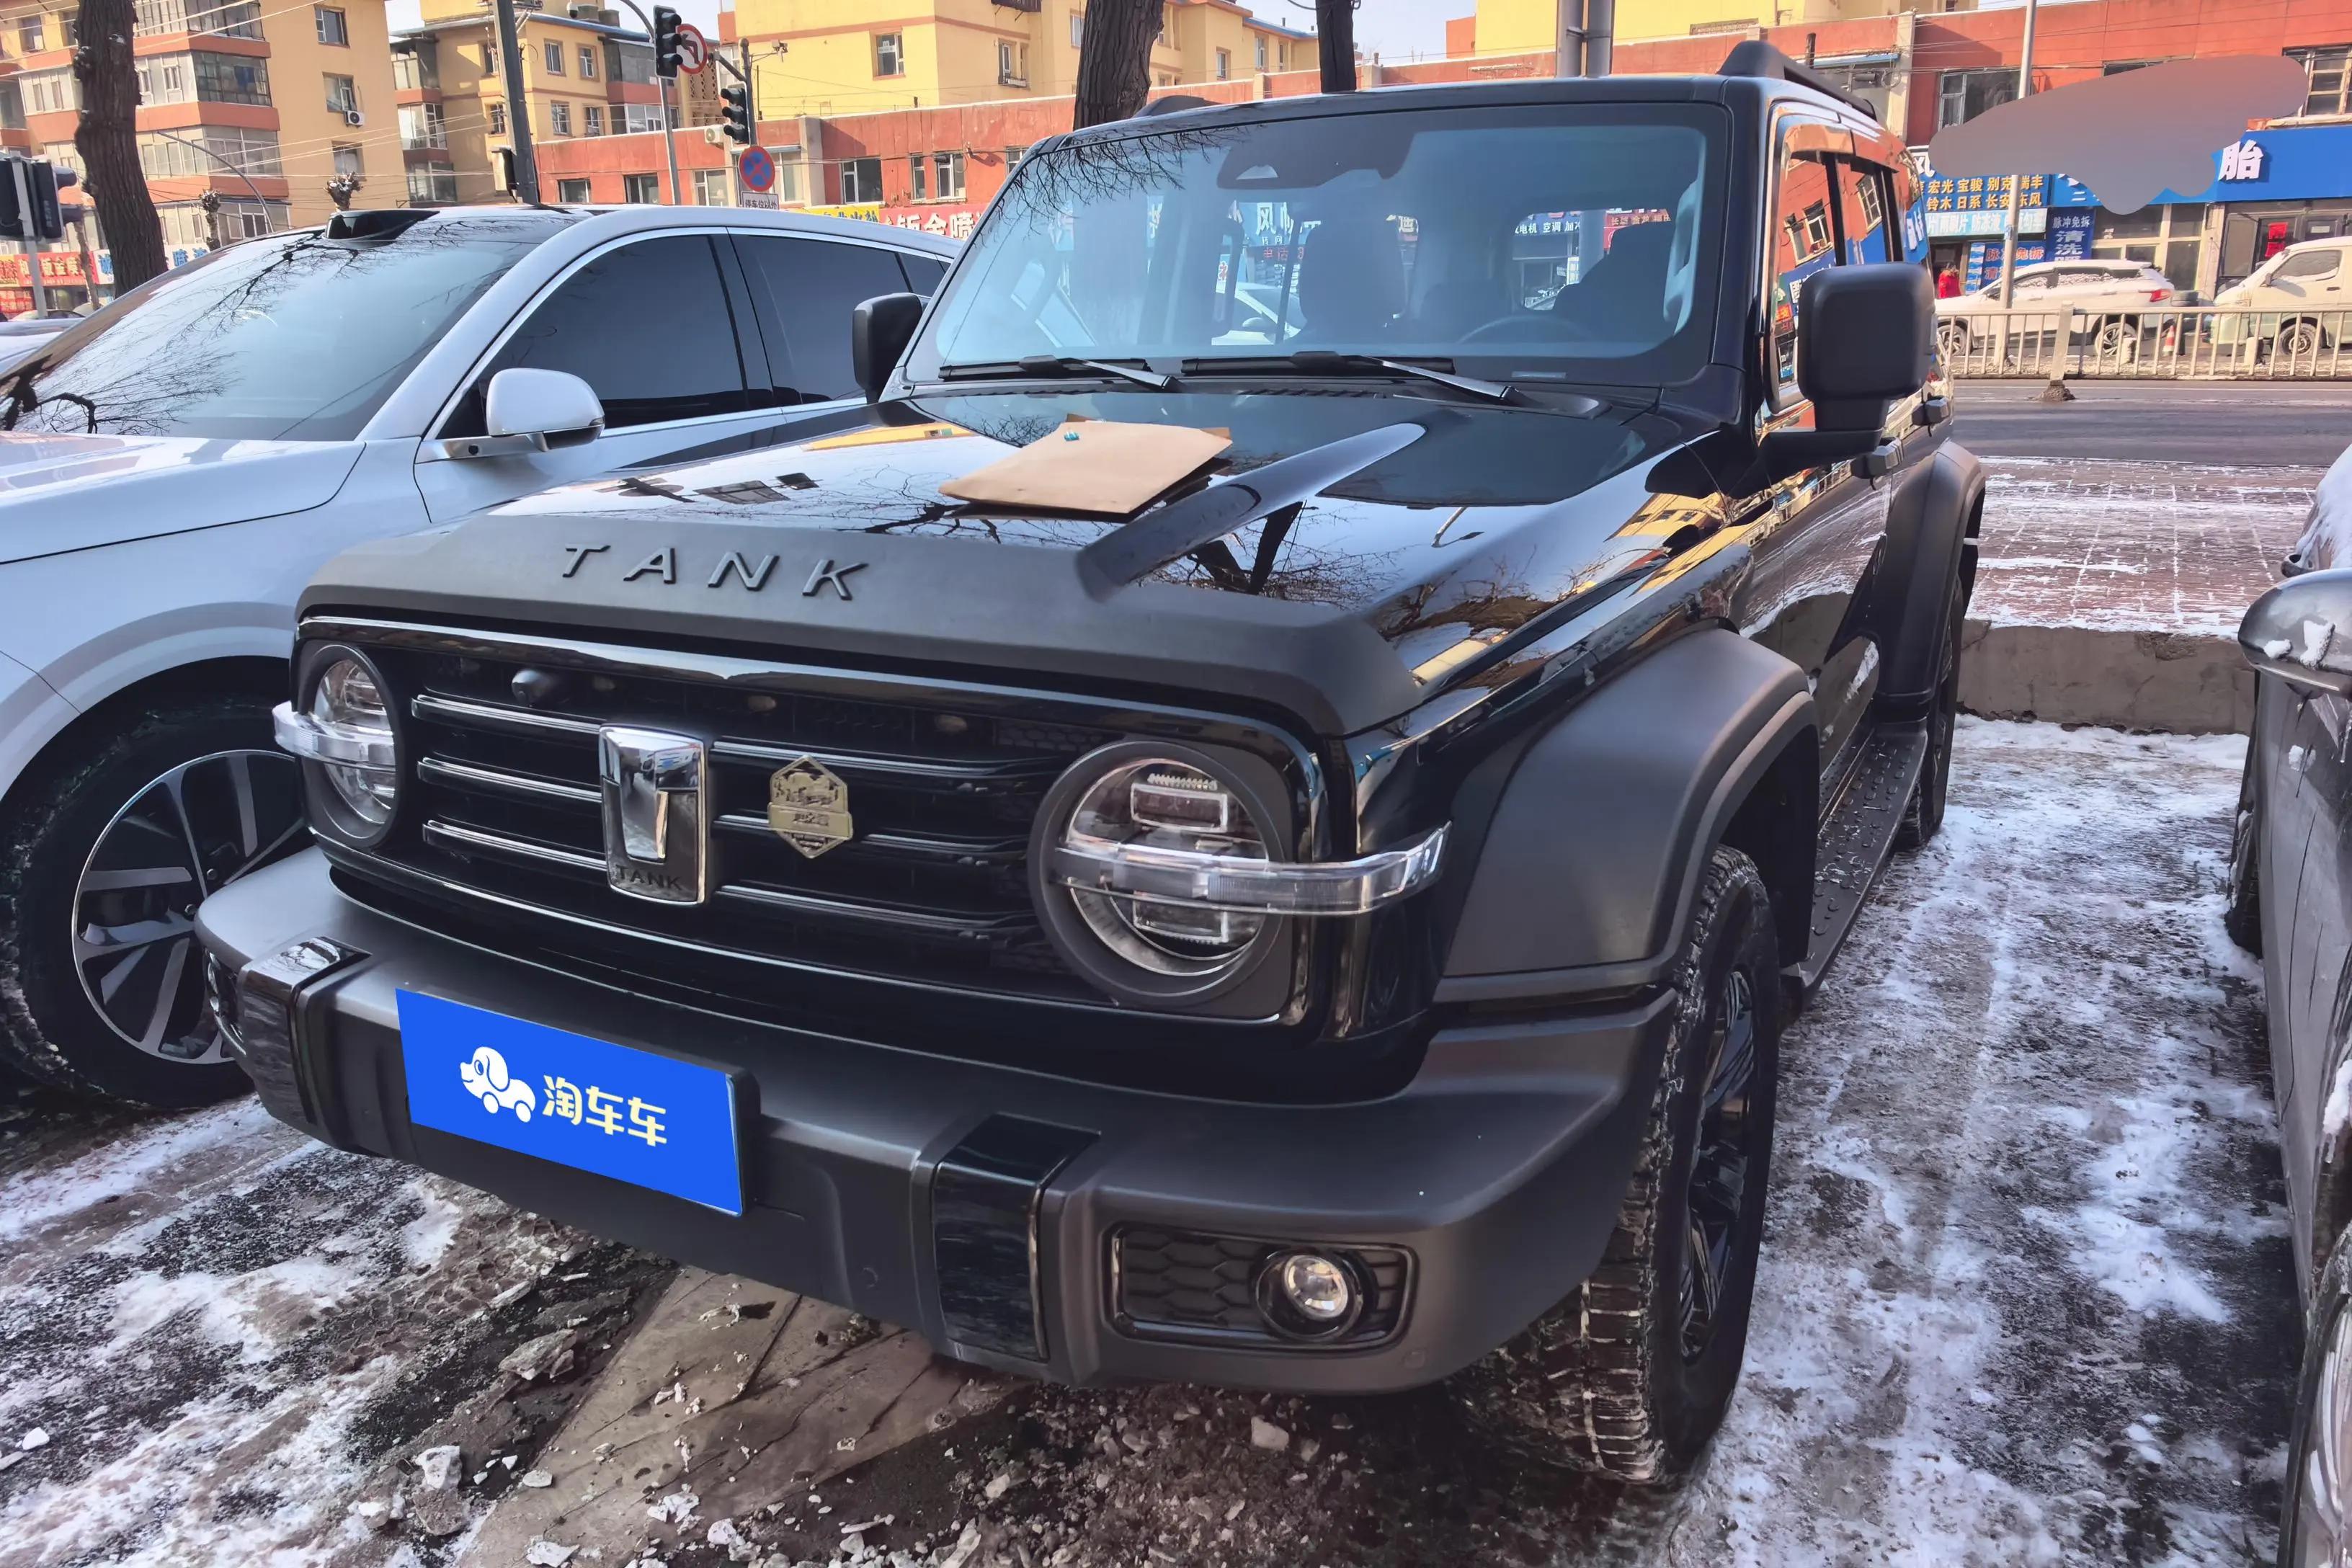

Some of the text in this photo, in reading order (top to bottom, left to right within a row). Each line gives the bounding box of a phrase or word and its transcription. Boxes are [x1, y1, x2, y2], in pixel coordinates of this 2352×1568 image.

[2218, 139, 2263, 180] 胎
[1928, 179, 1954, 193] 宏光
[1957, 178, 1983, 192] 宝骏
[1987, 176, 2013, 191] 别克
[745, 199, 777, 210] 停车位以外
[1926, 192, 2042, 210] 铃木 日系 长安 东风
[885, 212, 981, 241] 钣金喷
[1544, 221, 1561, 233] 空调
[2052, 215, 2090, 228] 脉冲免拆
[1986, 246, 2045, 261] 脉免拆
[563, 544, 869, 601] TANK
[615, 864, 683, 891] TANK
